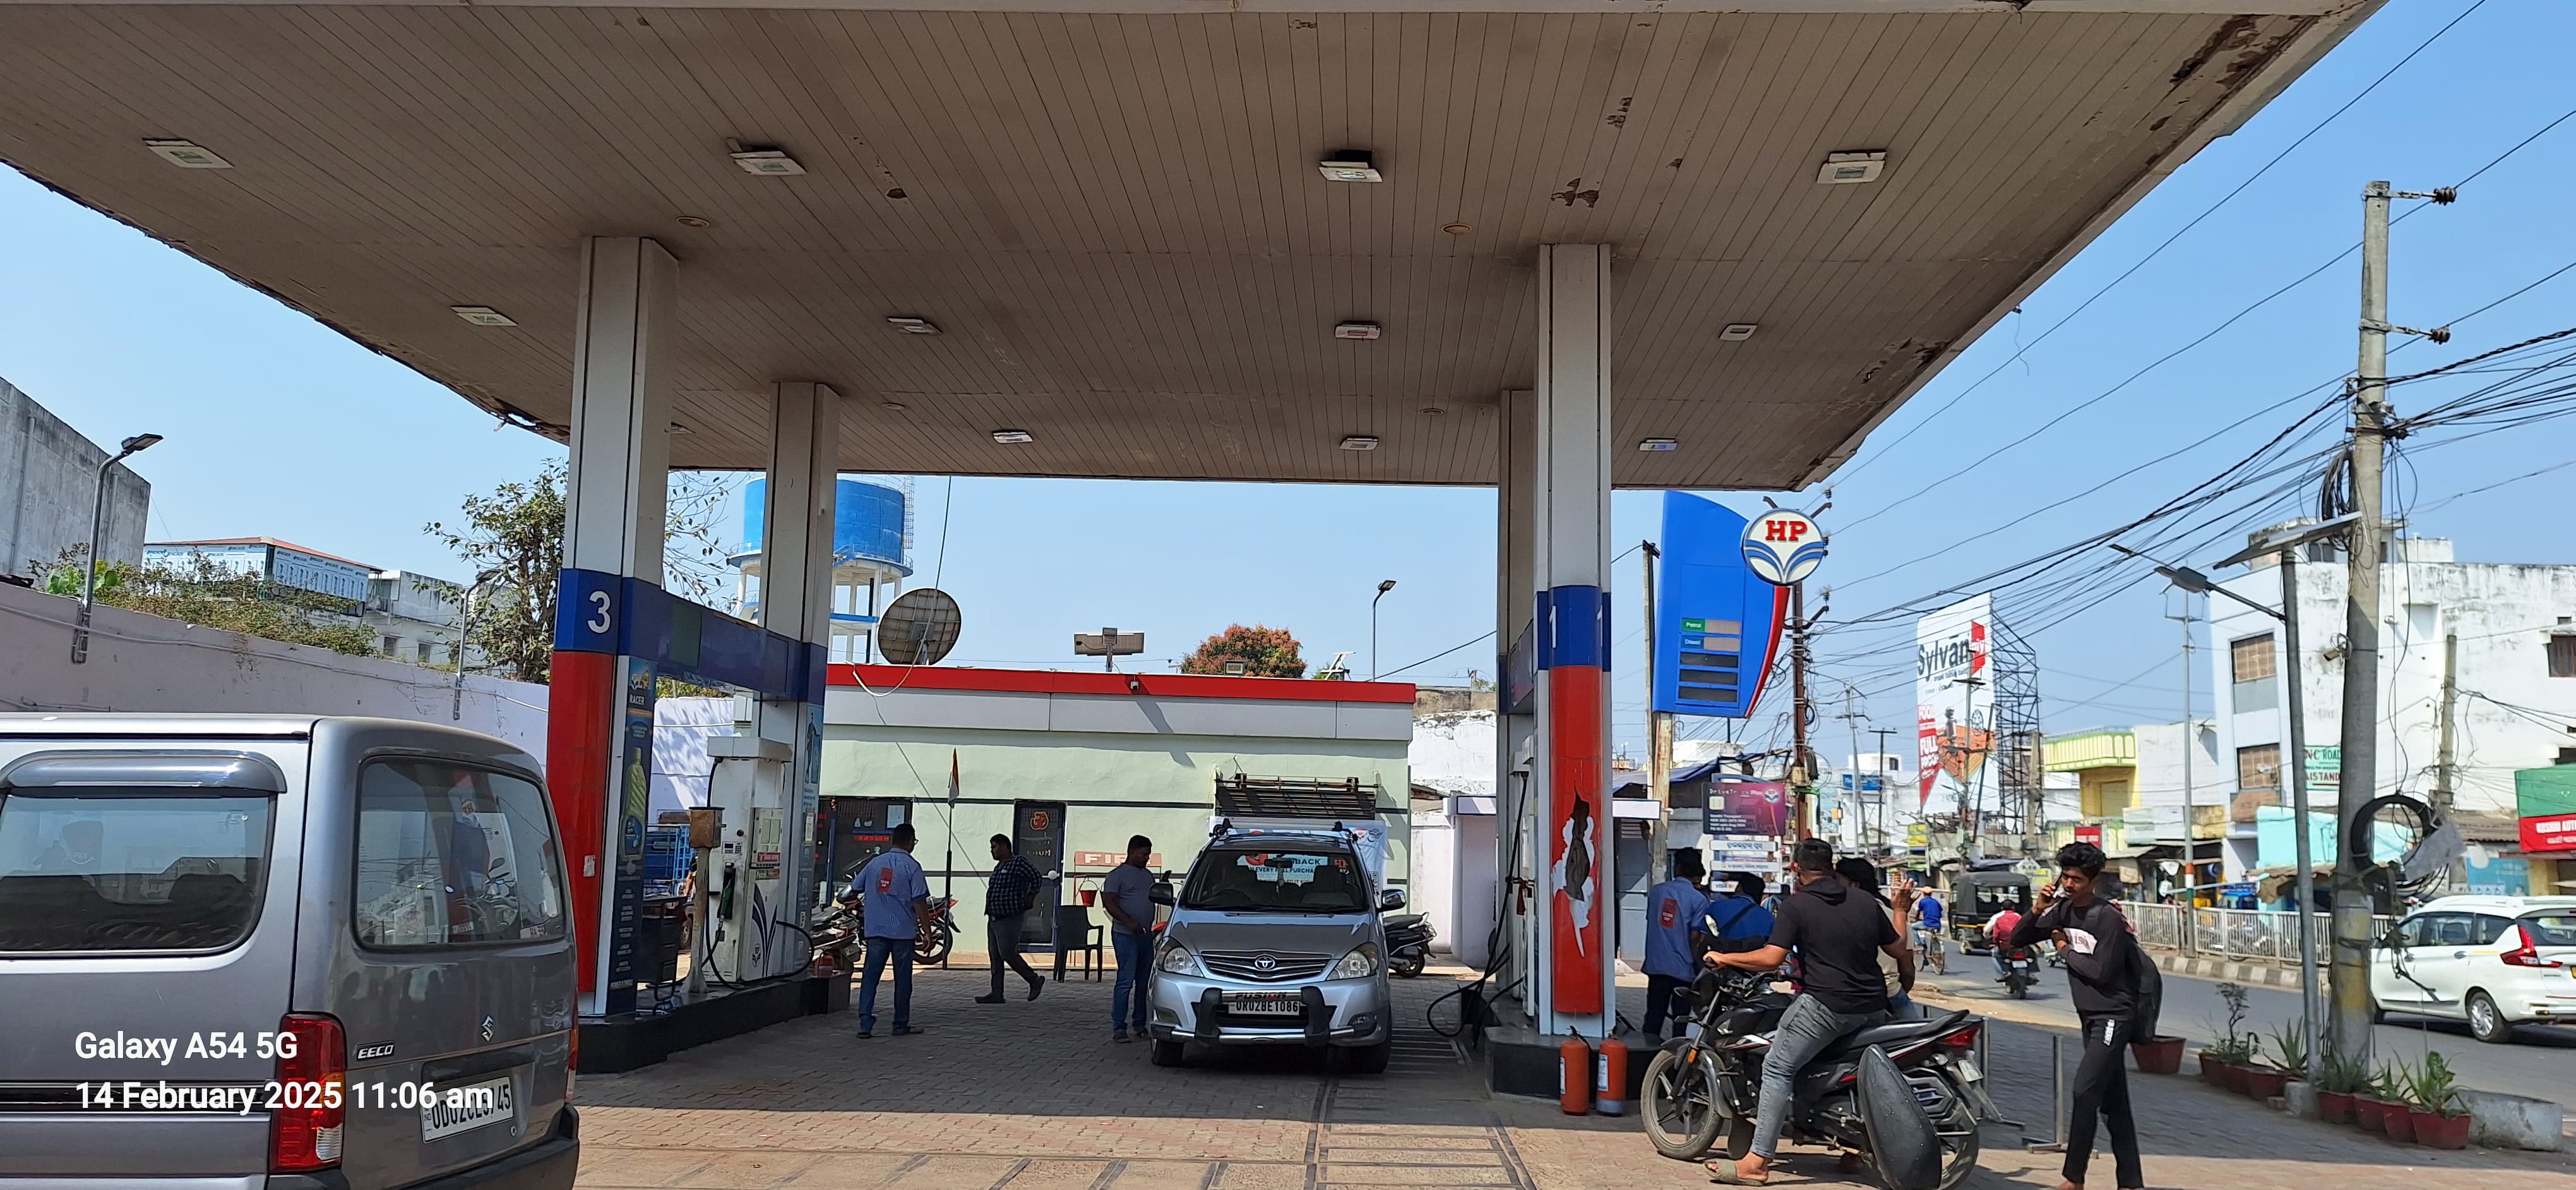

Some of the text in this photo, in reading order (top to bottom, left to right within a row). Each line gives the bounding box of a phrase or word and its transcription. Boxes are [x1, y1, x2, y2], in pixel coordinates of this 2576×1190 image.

[1765, 520, 1808, 541] HP
[587, 591, 611, 634] 3
[1549, 606, 1556, 648] 1
[629, 694, 645, 706] RACER
[357, 1044, 394, 1059] EECO
